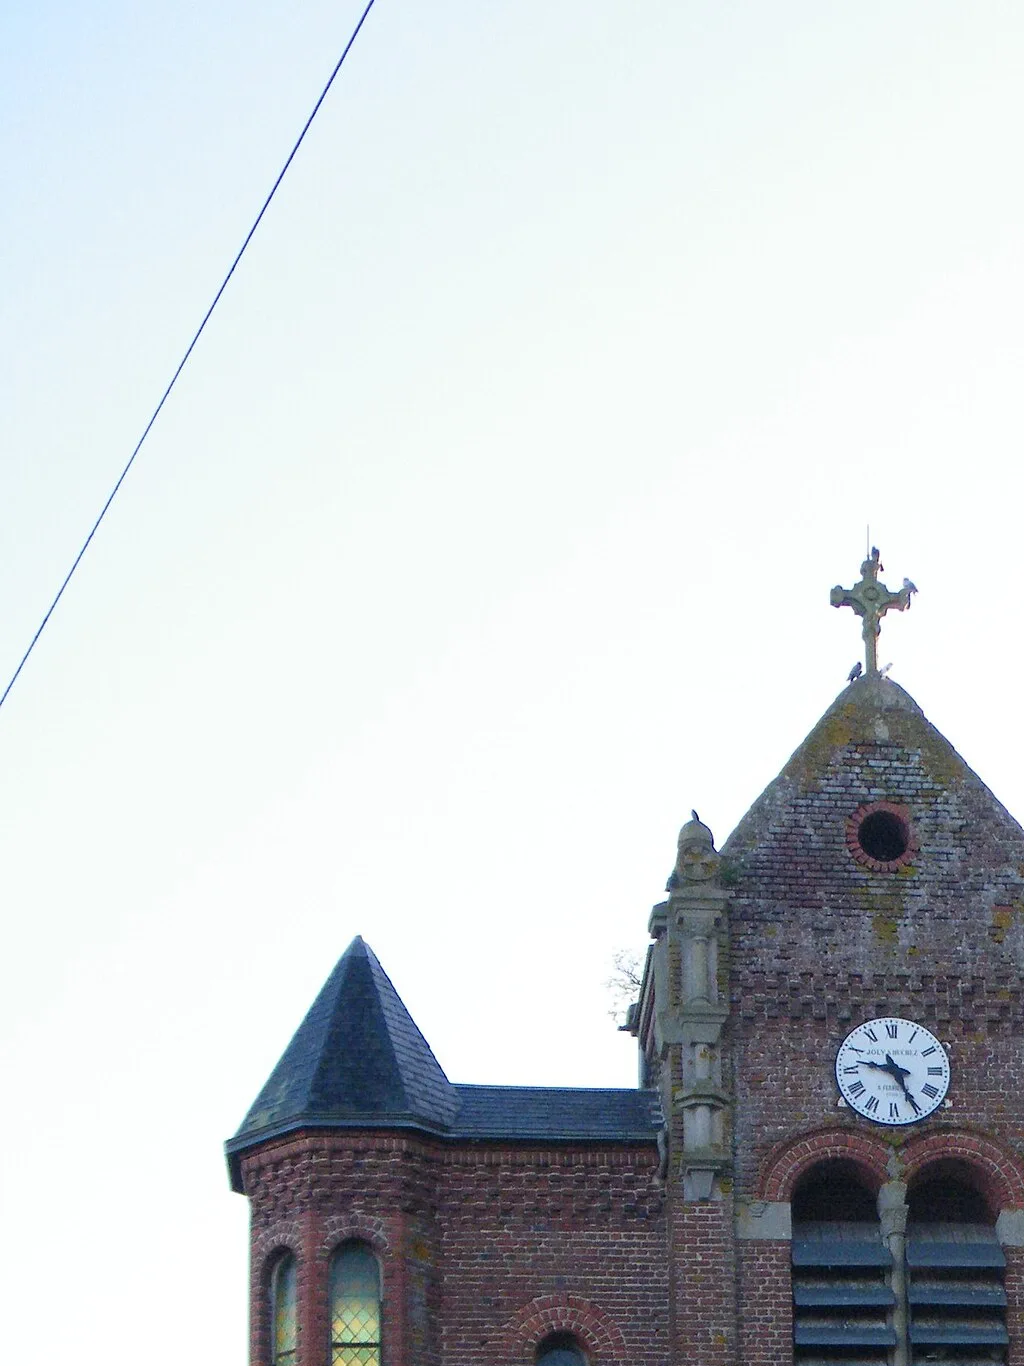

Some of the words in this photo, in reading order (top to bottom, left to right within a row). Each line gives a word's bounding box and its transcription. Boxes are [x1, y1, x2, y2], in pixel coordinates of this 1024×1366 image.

[885, 1024, 898, 1039] XII
[921, 1046, 936, 1057] II
[927, 1067, 943, 1076] III
[921, 1083, 939, 1099] IIII
